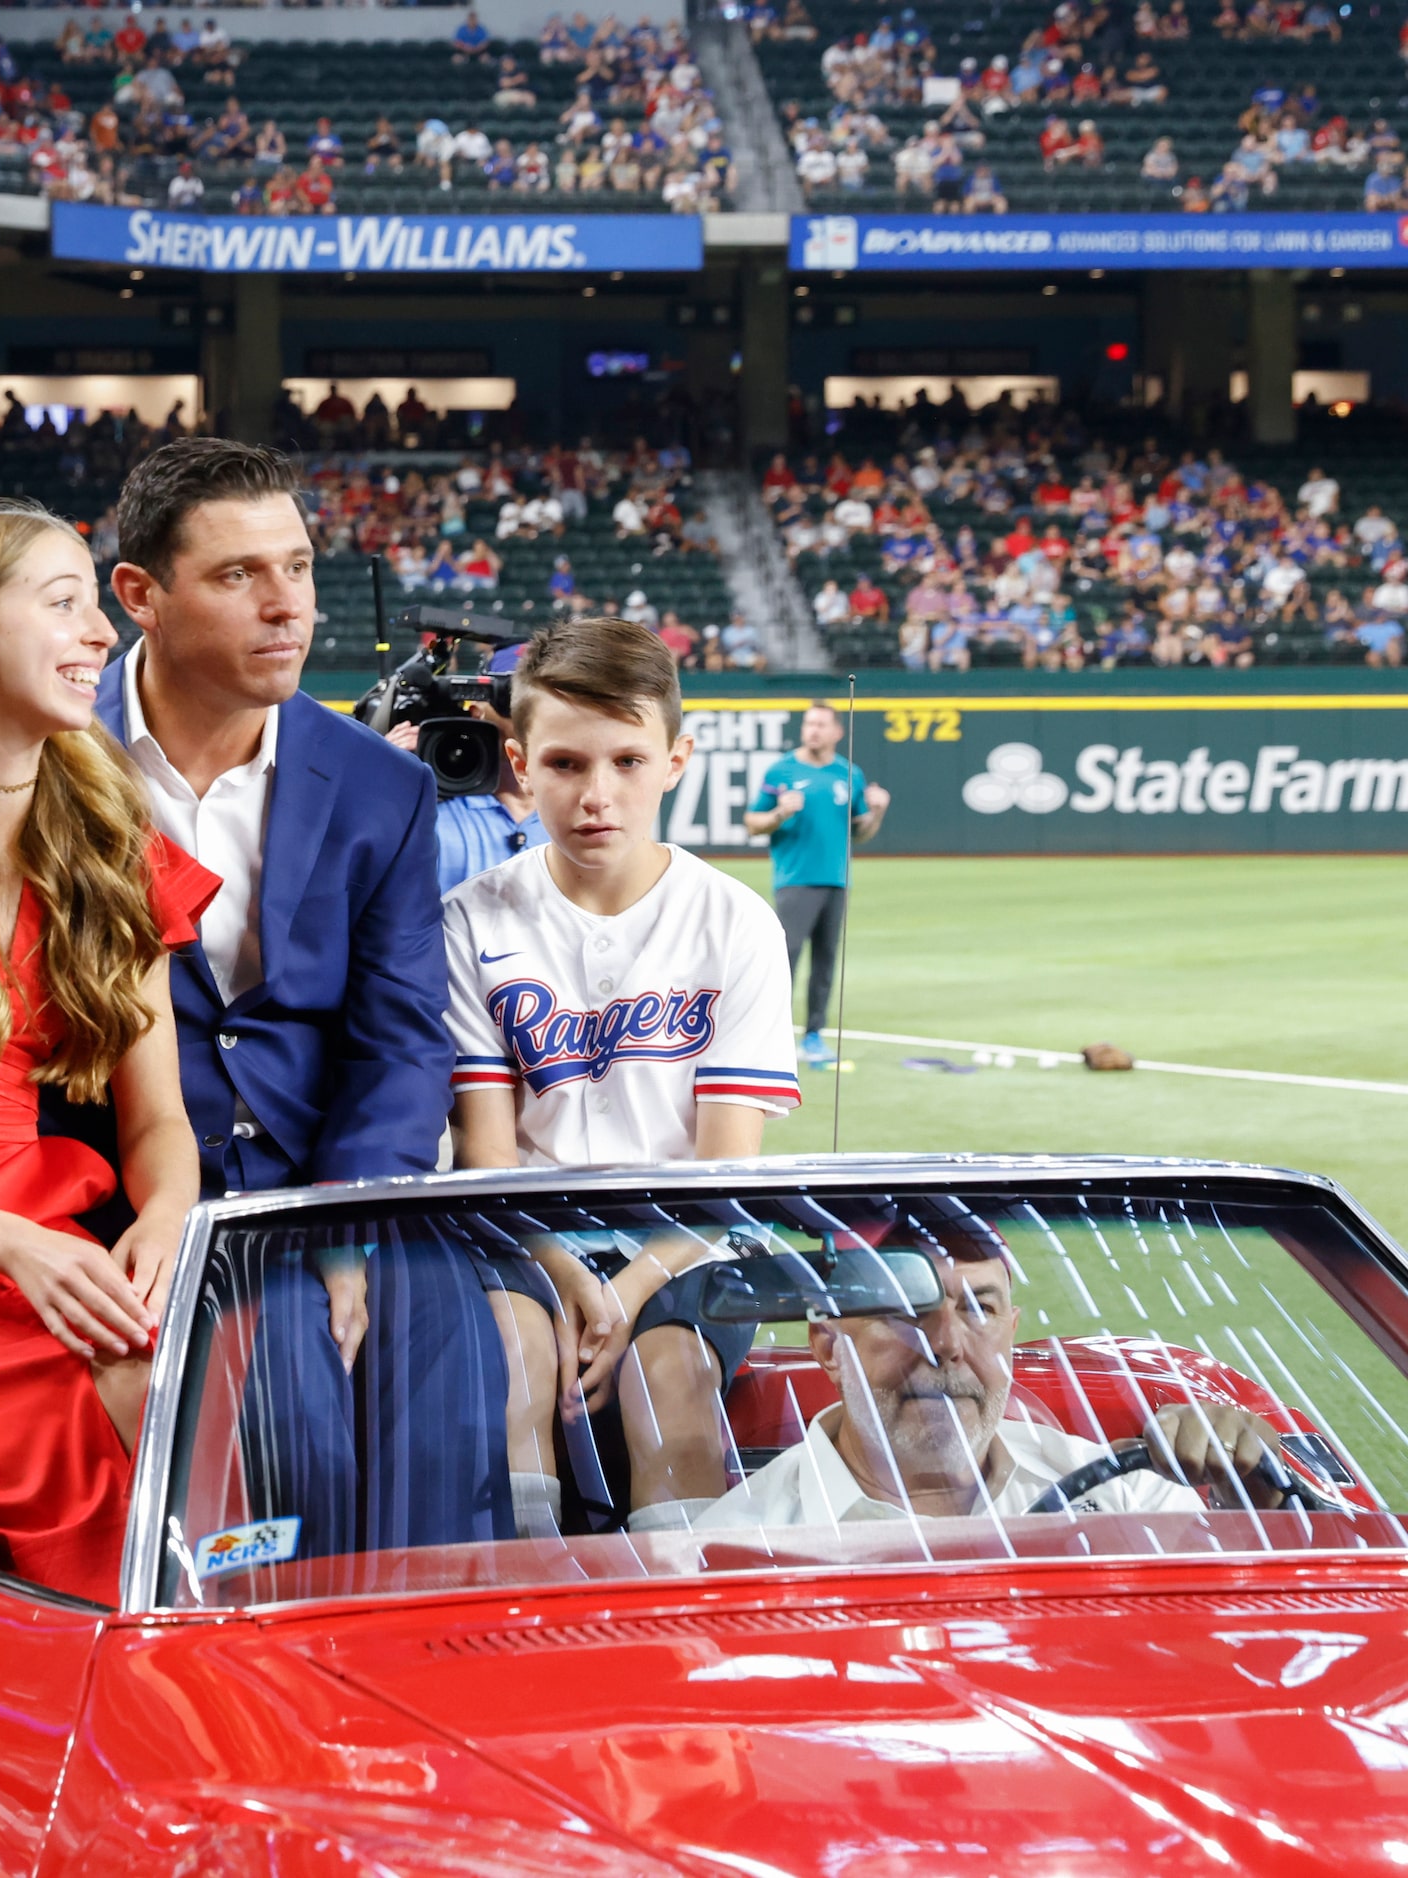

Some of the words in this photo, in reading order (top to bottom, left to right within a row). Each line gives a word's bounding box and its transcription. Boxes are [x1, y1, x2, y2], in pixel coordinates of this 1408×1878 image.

[1143, 229, 1228, 254] SOLUTIONS
[1329, 230, 1392, 254] GARDEN
[884, 710, 962, 742] 372
[486, 977, 722, 1099] Rangers
[207, 1539, 278, 1569] NCRS
